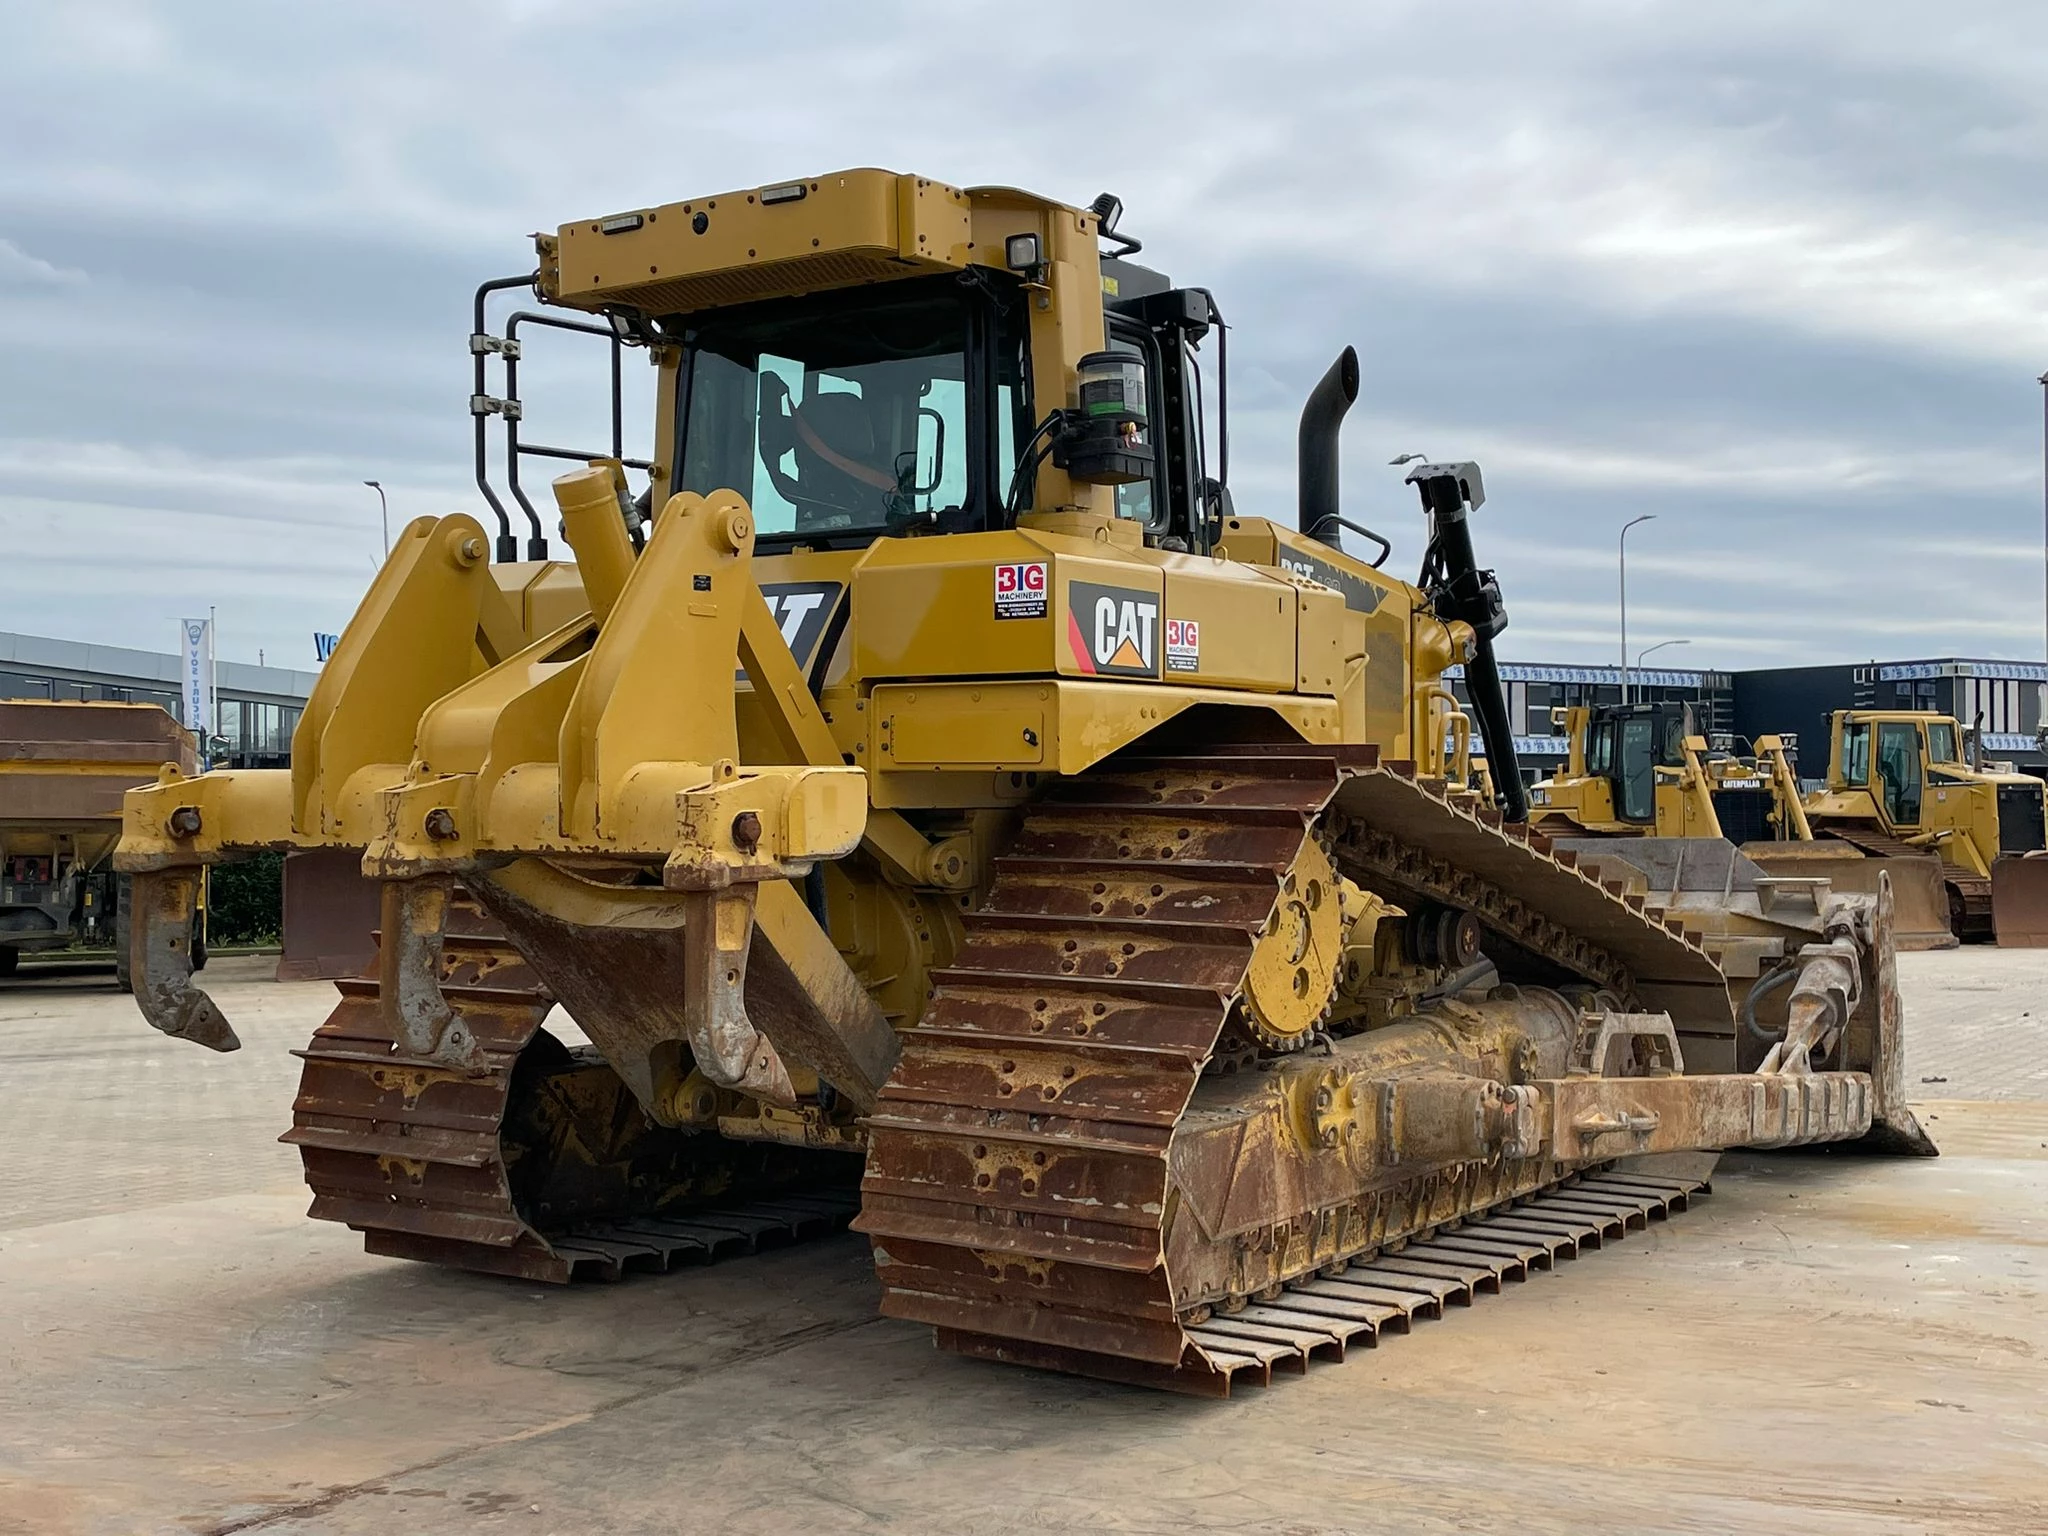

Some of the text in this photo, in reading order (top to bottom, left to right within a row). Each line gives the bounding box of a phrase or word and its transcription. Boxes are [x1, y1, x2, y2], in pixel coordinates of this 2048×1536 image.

[998, 565, 1043, 592] BIG
[998, 592, 1043, 601] MACHINERY
[1094, 596, 1157, 670] CAT
[1169, 621, 1197, 647] BIG
[1169, 646, 1197, 654] MACHINERY
[1722, 779, 1761, 789] CATERPILLAR
[1533, 789, 1544, 804] CAT
